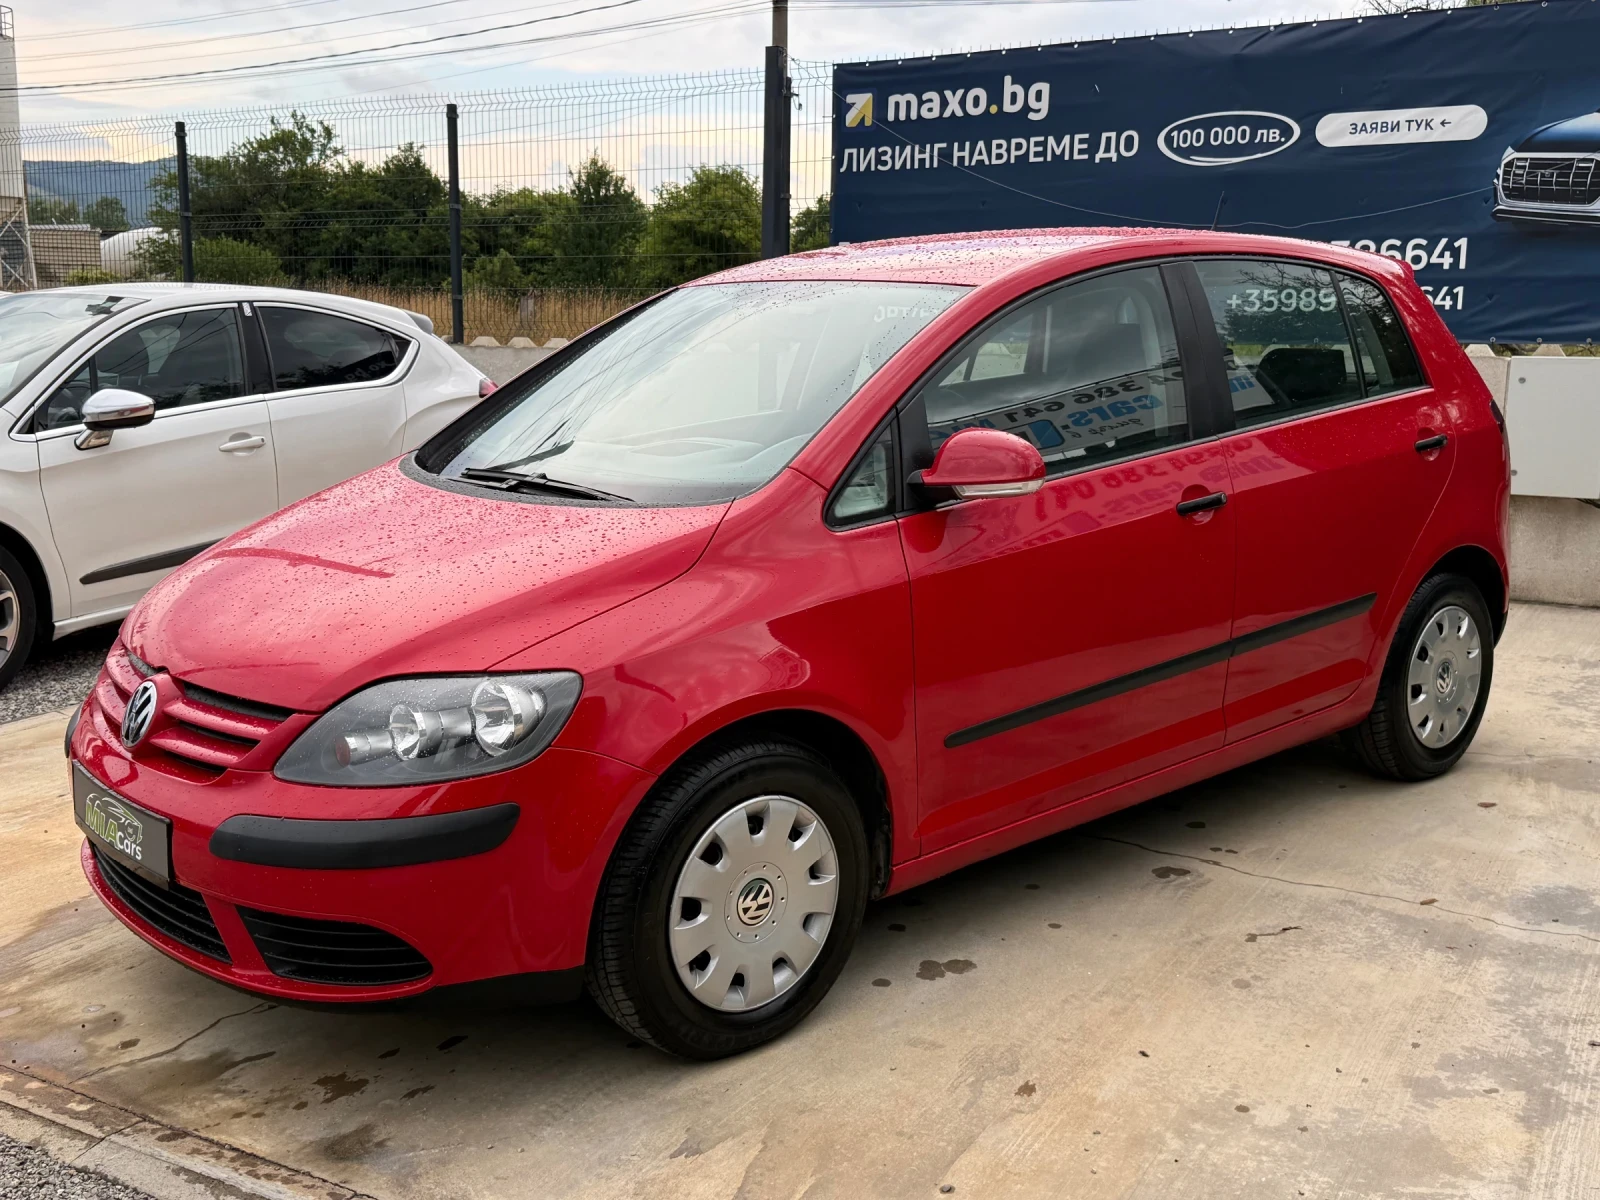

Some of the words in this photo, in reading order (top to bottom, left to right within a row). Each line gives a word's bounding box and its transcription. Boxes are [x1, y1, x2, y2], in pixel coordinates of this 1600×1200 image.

[887, 75, 1050, 121] maxo.bg
[840, 143, 947, 173] ЛИЗИНГ
[953, 133, 1089, 167] НАВРЕМЕ
[1095, 130, 1139, 163] ДО
[1170, 129, 1205, 149] 100
[1210, 125, 1250, 146] 000
[1254, 129, 1286, 143] лв.
[1349, 120, 1400, 135] ЗАЯВИ
[1405, 118, 1435, 132] ТУК
